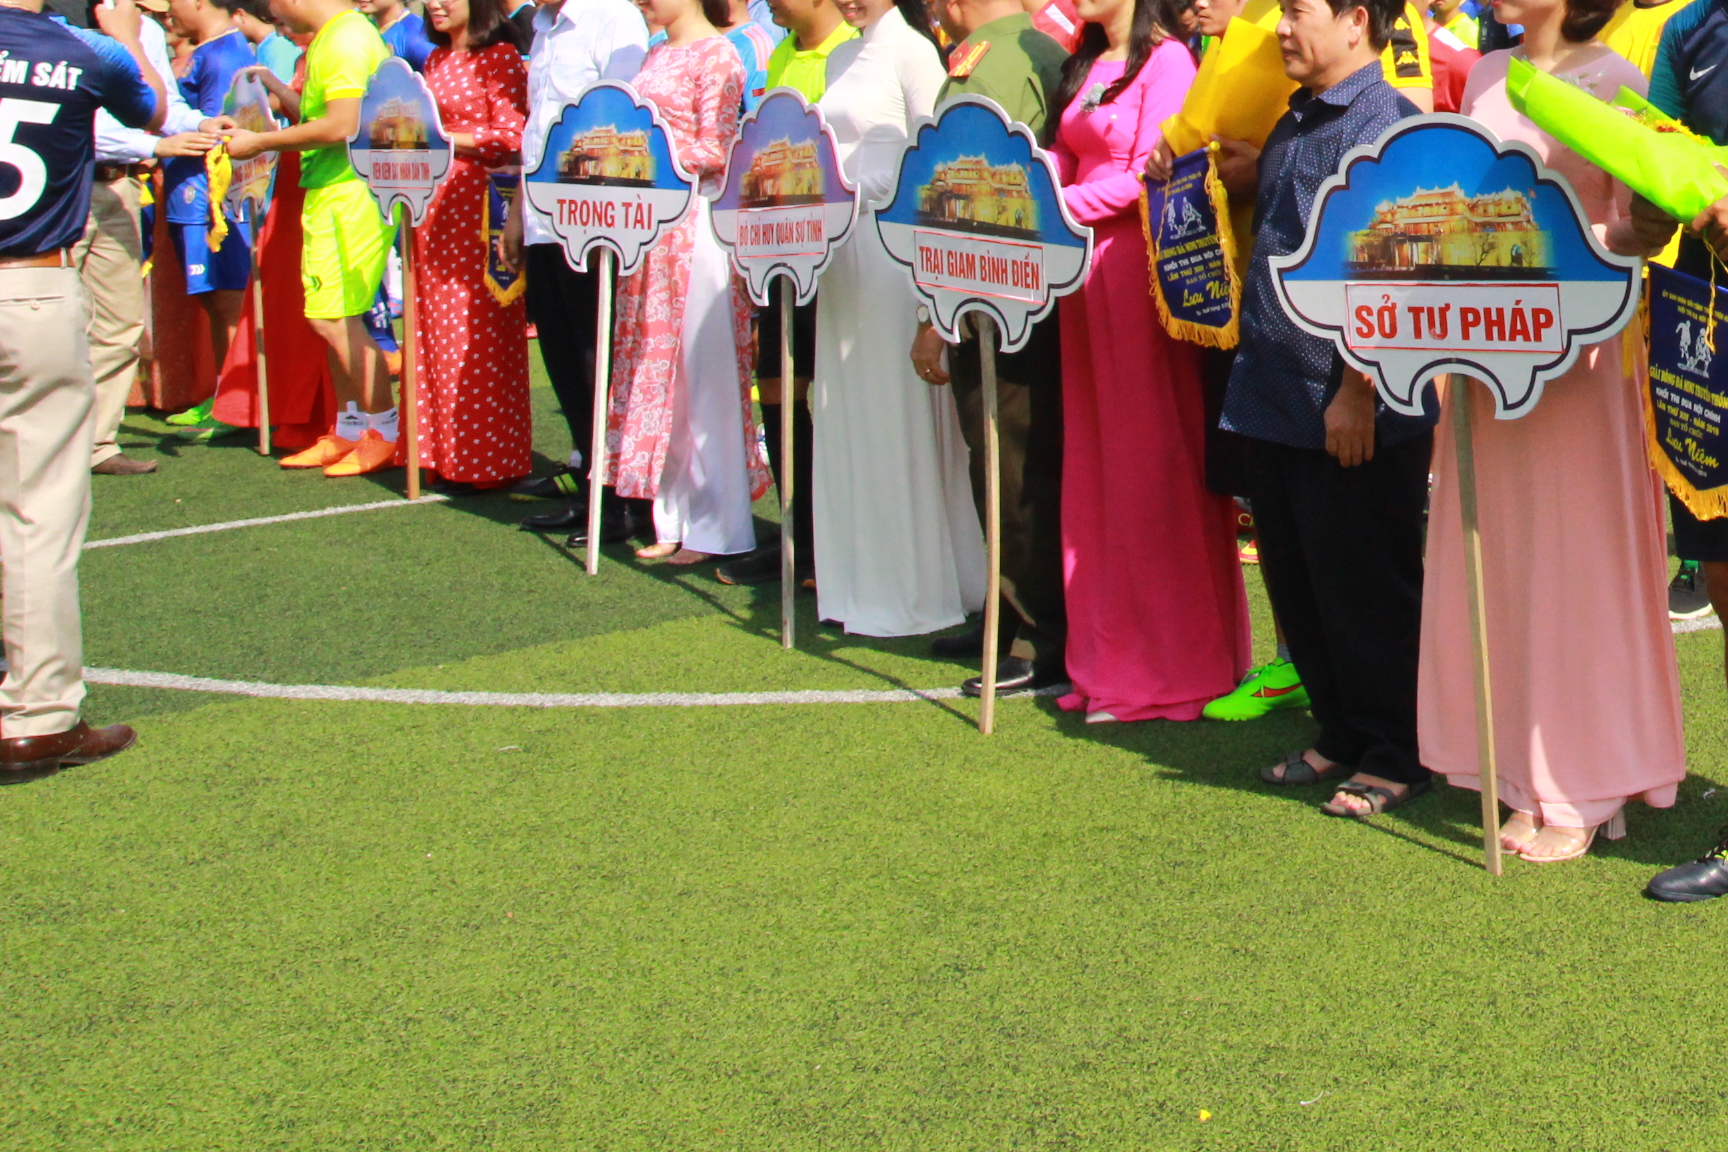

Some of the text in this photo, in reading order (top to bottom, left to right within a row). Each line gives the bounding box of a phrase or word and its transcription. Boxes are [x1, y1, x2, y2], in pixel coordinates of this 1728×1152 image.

[32, 61, 84, 91] SÁT
[557, 194, 653, 234] TRỌNG TÀI
[762, 223, 775, 245] HUY
[776, 217, 794, 246] QUÂN
[806, 212, 822, 242] TỈNH
[919, 246, 944, 280] TRẠI
[947, 250, 976, 280] GIAM
[980, 250, 1008, 285] BÌNH
[1355, 294, 1554, 342] SỞ TƯ PHÁP
[1685, 438, 1719, 469] Niệm
